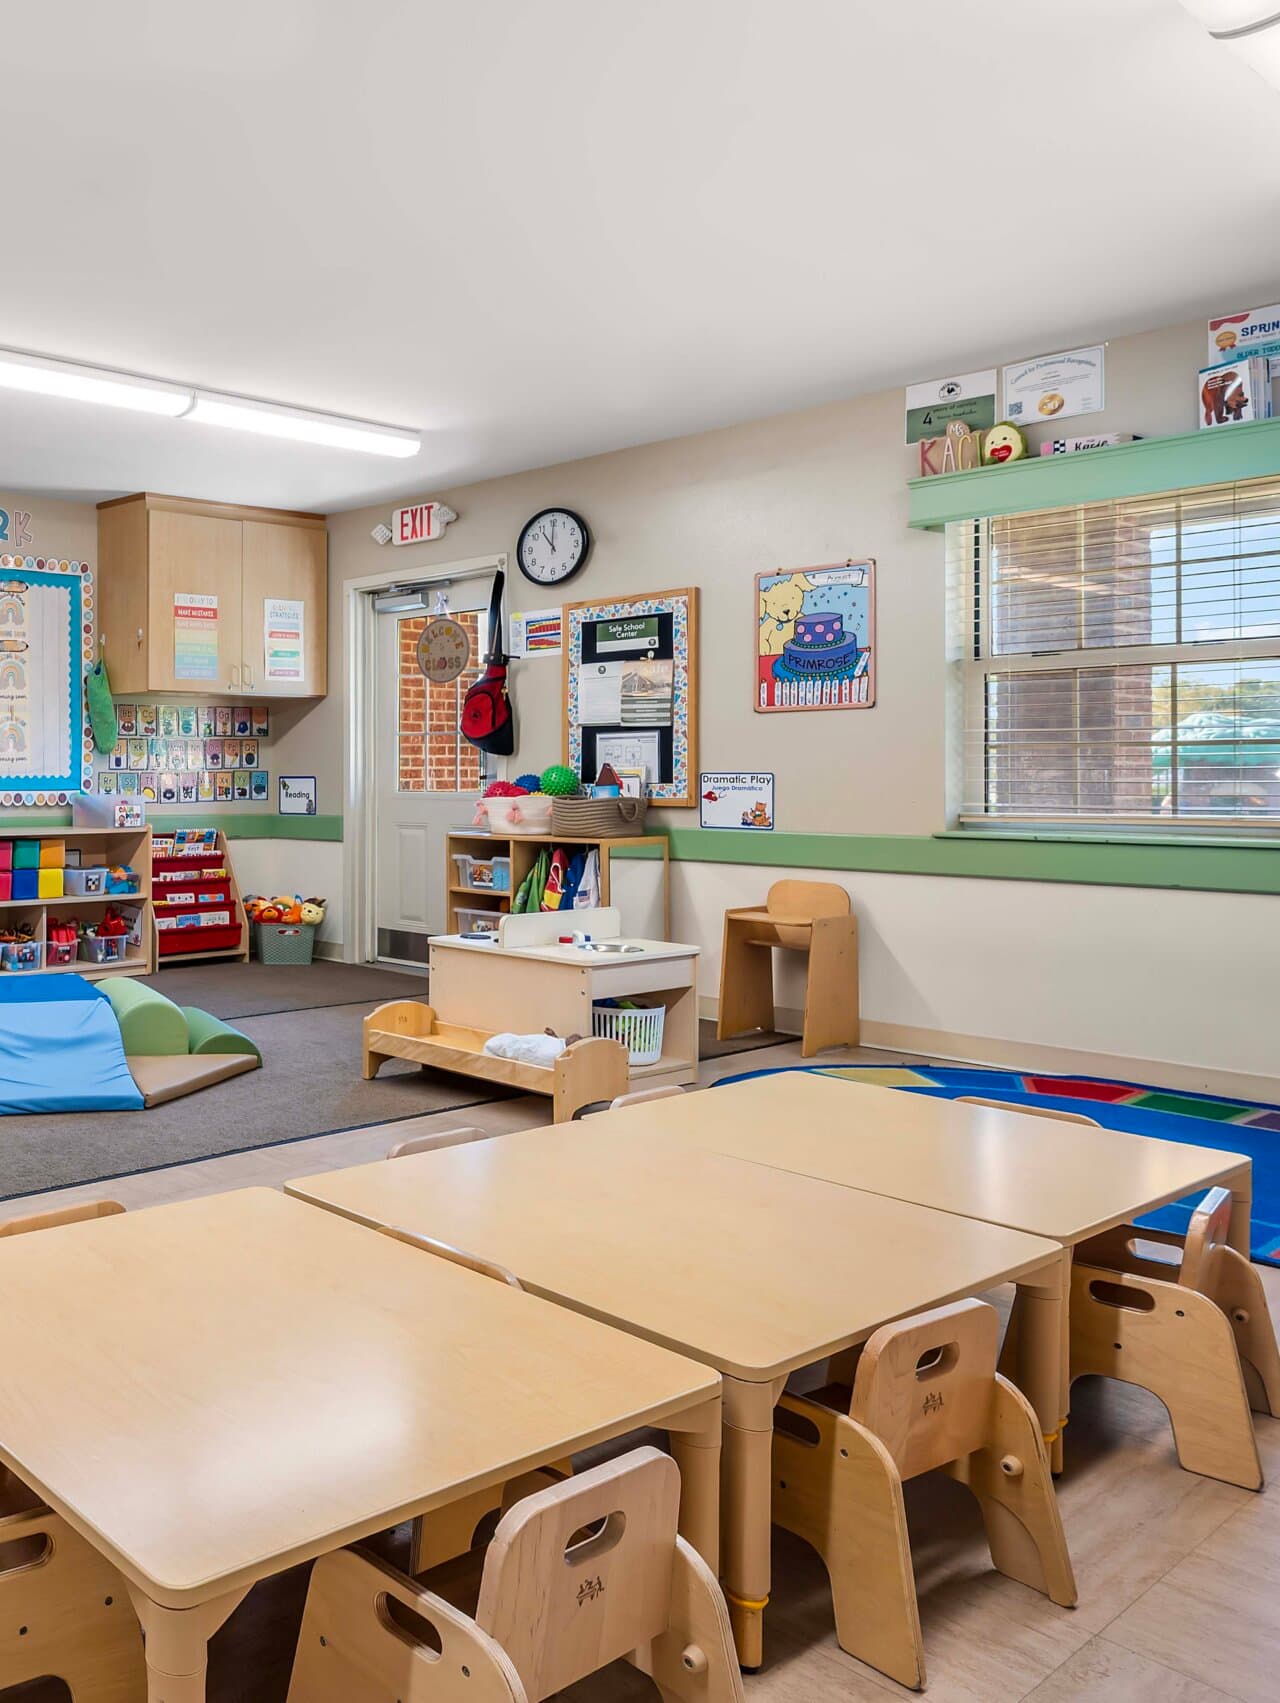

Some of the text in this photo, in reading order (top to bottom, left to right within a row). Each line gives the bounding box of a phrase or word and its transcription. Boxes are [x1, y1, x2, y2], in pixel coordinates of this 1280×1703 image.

[923, 412, 932, 425] 4
[400, 505, 434, 541] EXIT
[570, 527, 576, 536] 2
[532, 533, 539, 541] 10
[574, 540, 579, 548] 3
[528, 547, 533, 555] 9
[531, 558, 537, 566] 8
[540, 566, 545, 574] 7
[562, 563, 567, 571] 5
[624, 622, 646, 631] School
[616, 630, 638, 638] Center
[789, 653, 851, 670] PRIMROSE
[703, 775, 771, 785] Dramatic Play
[285, 791, 310, 800] Reading
